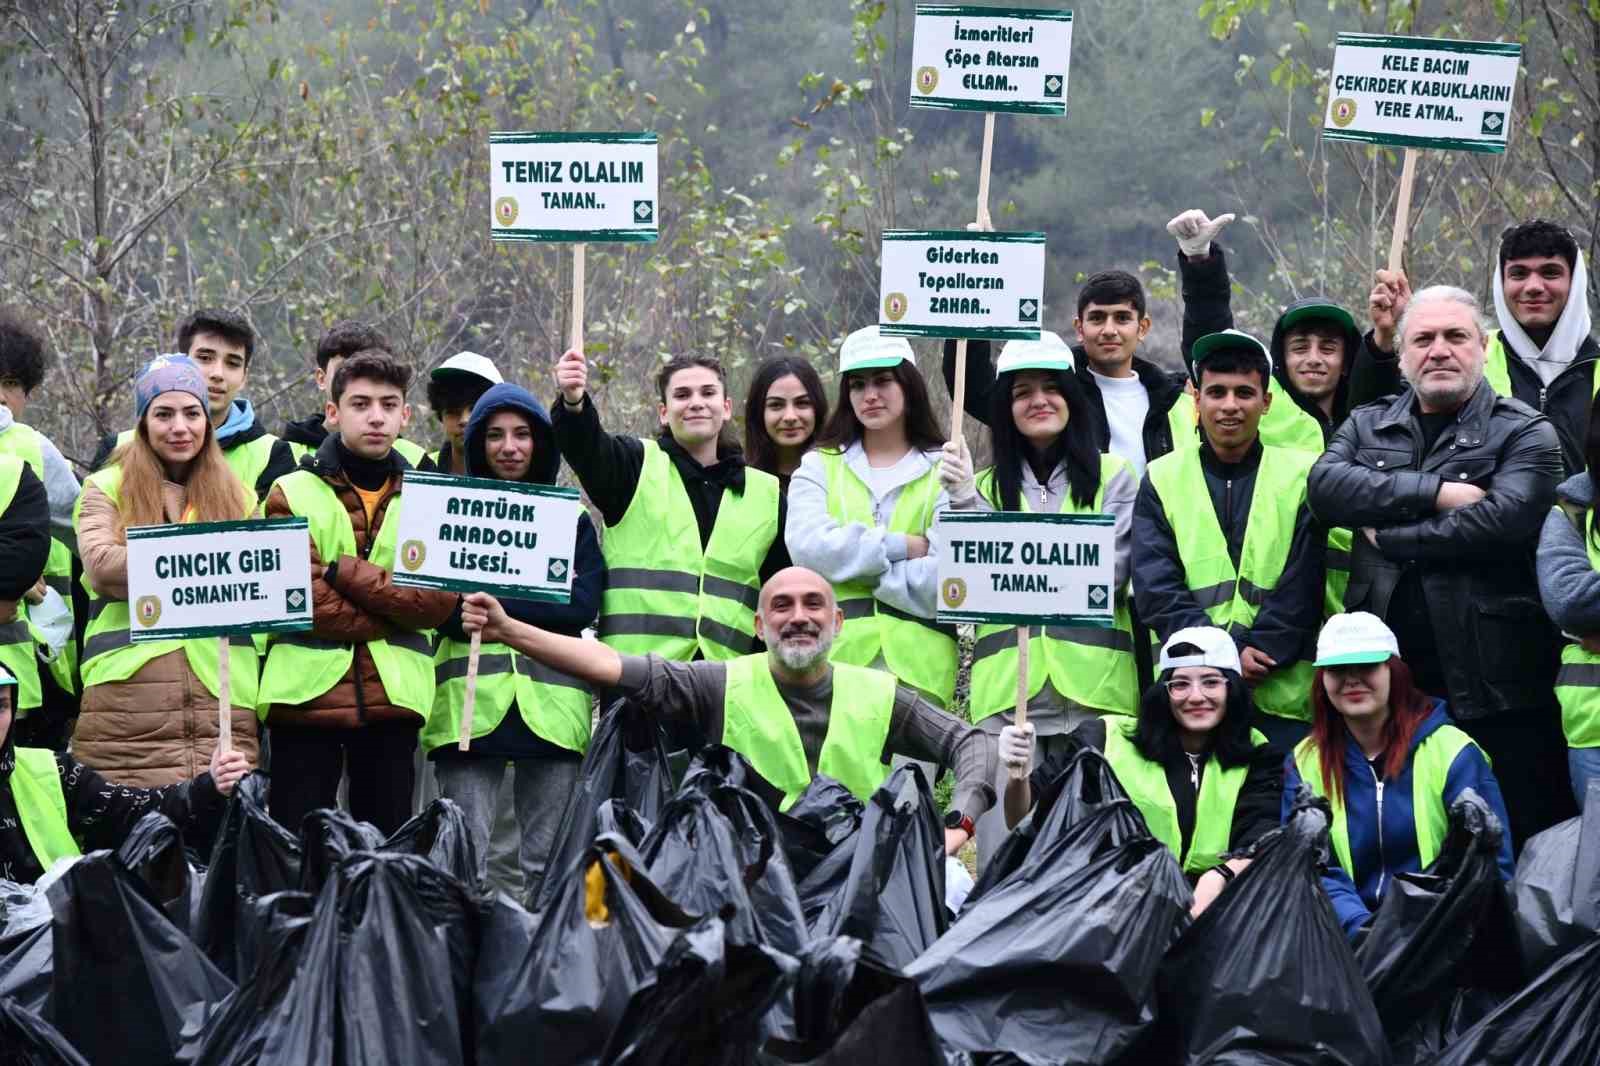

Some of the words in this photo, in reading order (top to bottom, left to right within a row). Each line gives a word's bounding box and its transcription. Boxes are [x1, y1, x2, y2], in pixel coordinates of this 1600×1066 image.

[954, 20, 1034, 43] İzmaritleri
[945, 49, 981, 69] Çöpe
[986, 50, 1039, 68] Atarsın
[1382, 54, 1419, 73] KELE
[1423, 57, 1470, 76] BACIM
[962, 73, 1018, 92] ELLAM..
[1411, 80, 1511, 102] KABUKLARINI
[1375, 100, 1412, 118] YERE
[1415, 104, 1463, 123] ATMA..
[569, 161, 644, 183] OLALIM
[541, 192, 605, 209] TAMAN..
[926, 246, 999, 265] Giderken
[918, 272, 1004, 292] Topallarsın
[446, 497, 536, 522] ATATÜRK
[439, 524, 538, 549] ANADOLU
[155, 551, 231, 579] CINCIK
[1020, 542, 1100, 567] OLALIM
[991, 573, 1058, 593] TAMAN..
